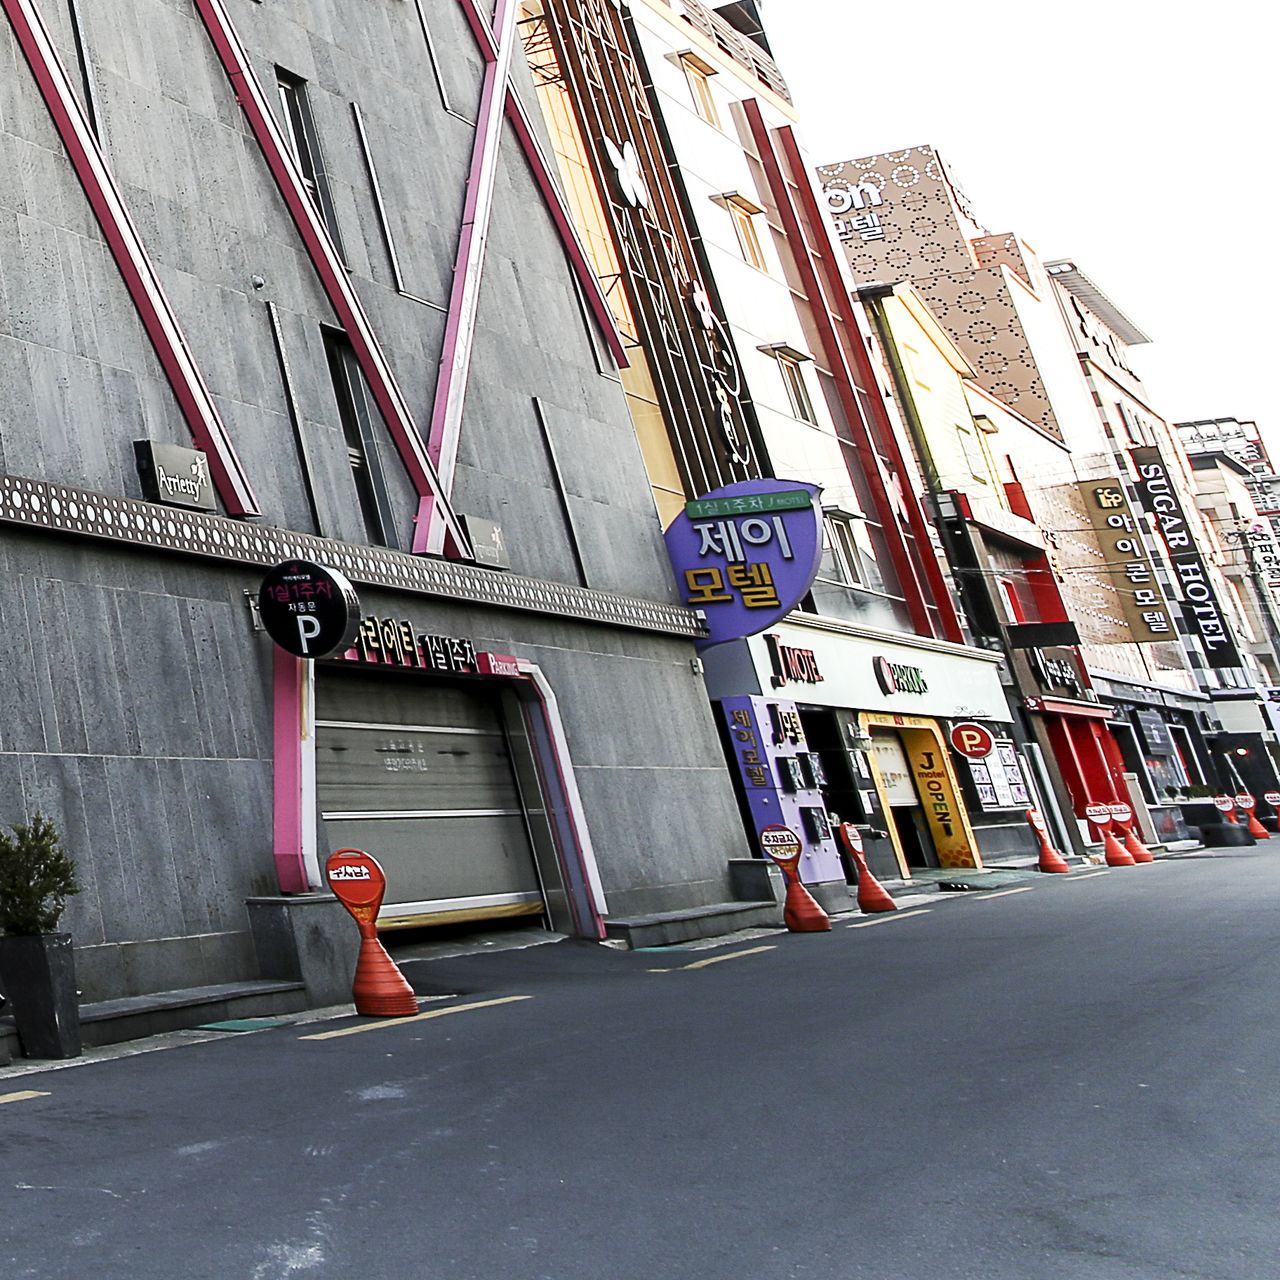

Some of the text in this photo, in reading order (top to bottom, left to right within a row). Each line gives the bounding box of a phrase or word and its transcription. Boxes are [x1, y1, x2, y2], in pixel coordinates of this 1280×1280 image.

[158, 466, 199, 501] Arrietty
[693, 516, 793, 562] 제이
[1140, 464, 1227, 650] SUGAR HOTEL
[685, 563, 781, 608] 모텔
[297, 615, 320, 653] P
[731, 710, 767, 786] 제이모텔
[920, 751, 934, 770] J
[961, 730, 981, 752] P
[918, 770, 945, 779] motel
[927, 780, 952, 823] OPEN
